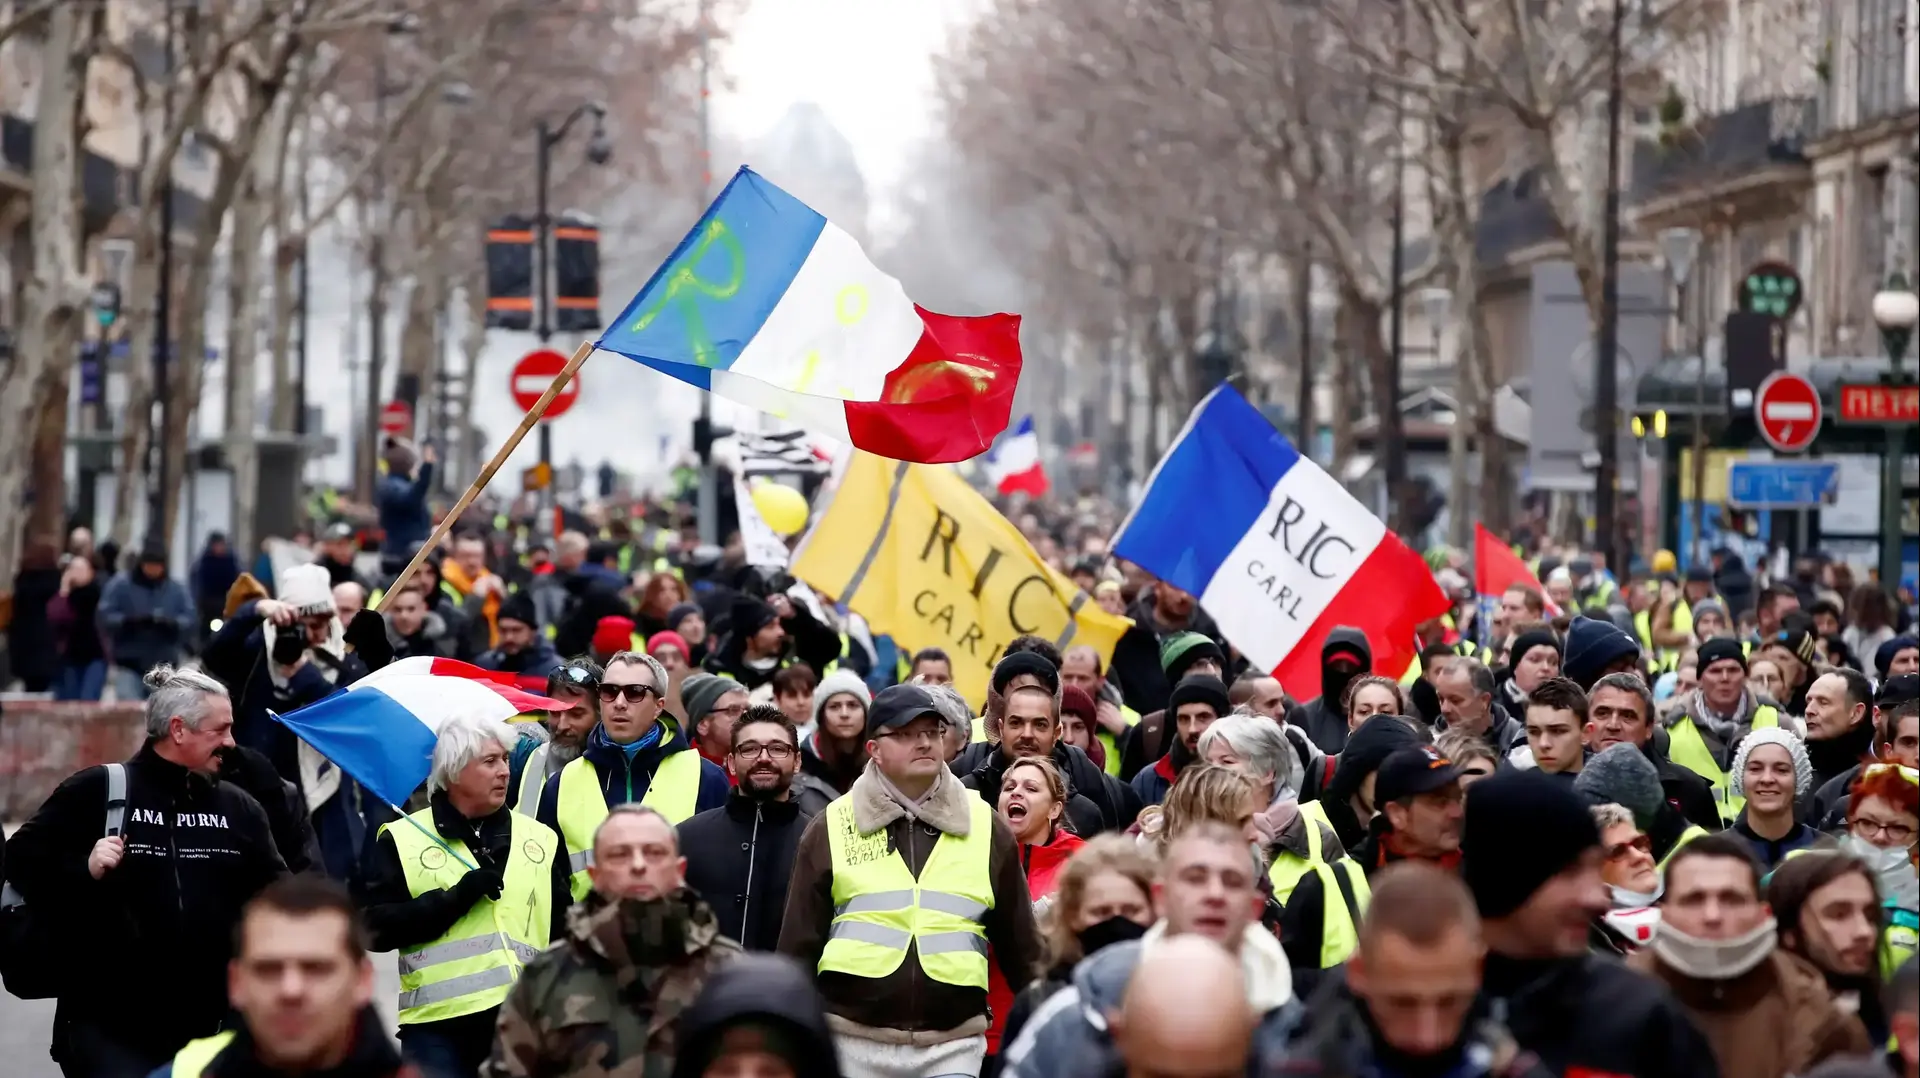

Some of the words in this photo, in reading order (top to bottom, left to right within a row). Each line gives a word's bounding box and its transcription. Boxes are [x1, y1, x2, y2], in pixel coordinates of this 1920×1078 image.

[920, 507, 1056, 635] RIC
[1268, 495, 1359, 580] RIC
[1247, 560, 1302, 621] CARL
[914, 589, 1004, 671] CARL
[845, 836, 888, 858] 05/01/19
[846, 848, 889, 866] 12/01/1
